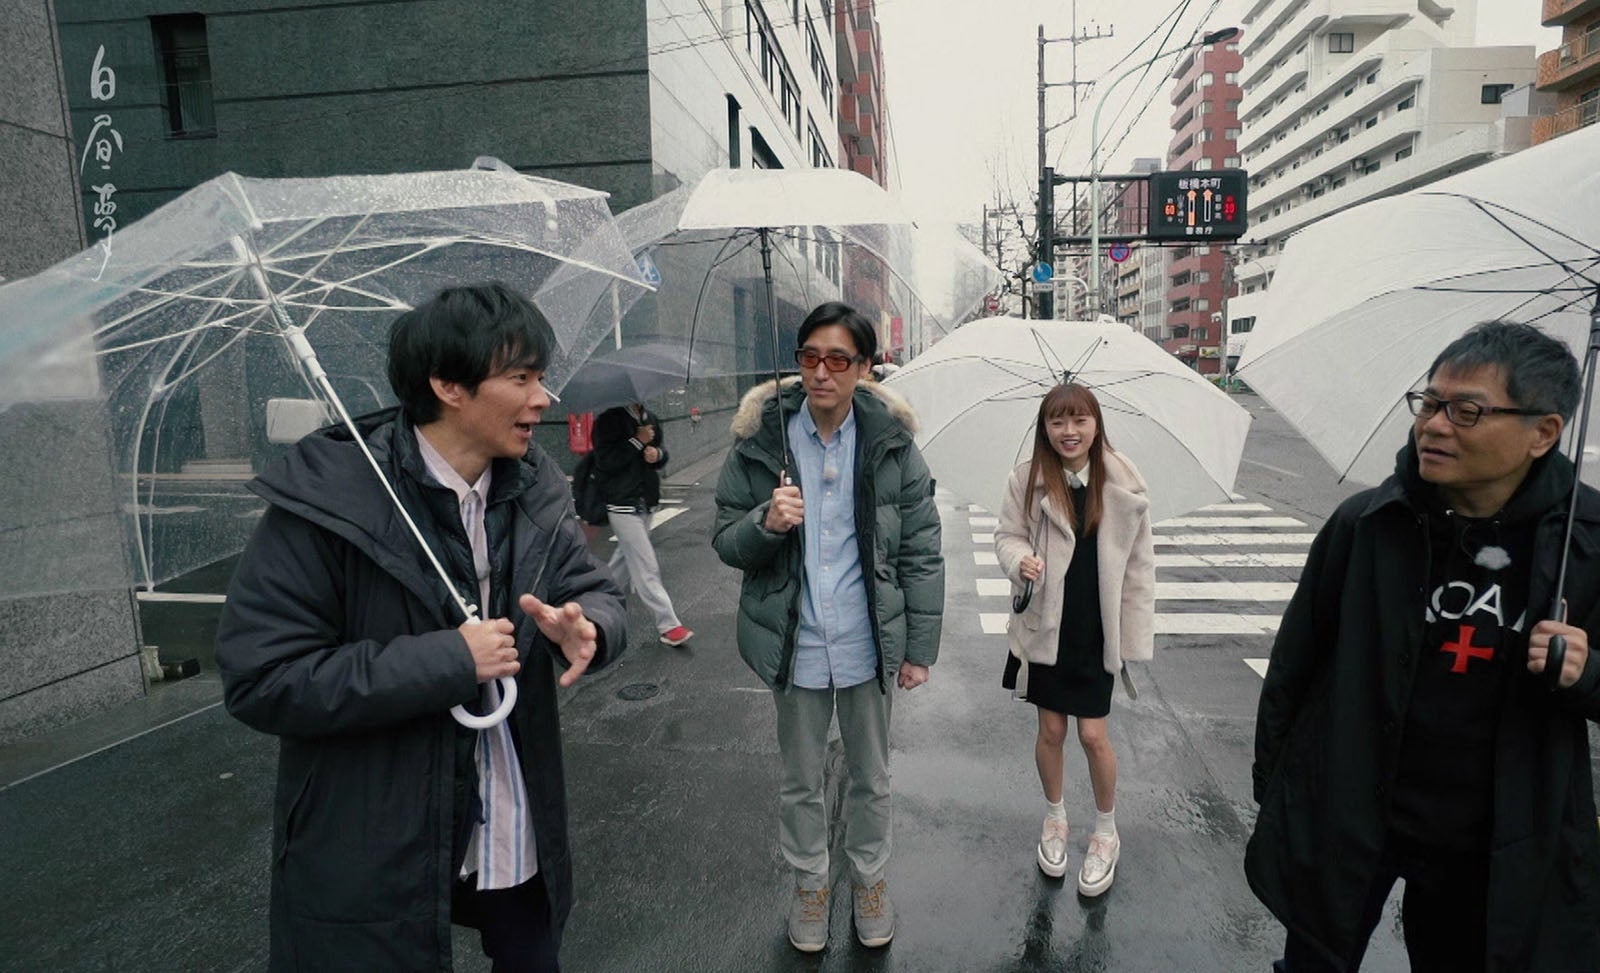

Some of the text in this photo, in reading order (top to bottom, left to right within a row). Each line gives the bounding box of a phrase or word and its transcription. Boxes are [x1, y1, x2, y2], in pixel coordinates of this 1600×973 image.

[1178, 178, 1222, 190] 板橋本町
[1425, 581, 1527, 632] OA
